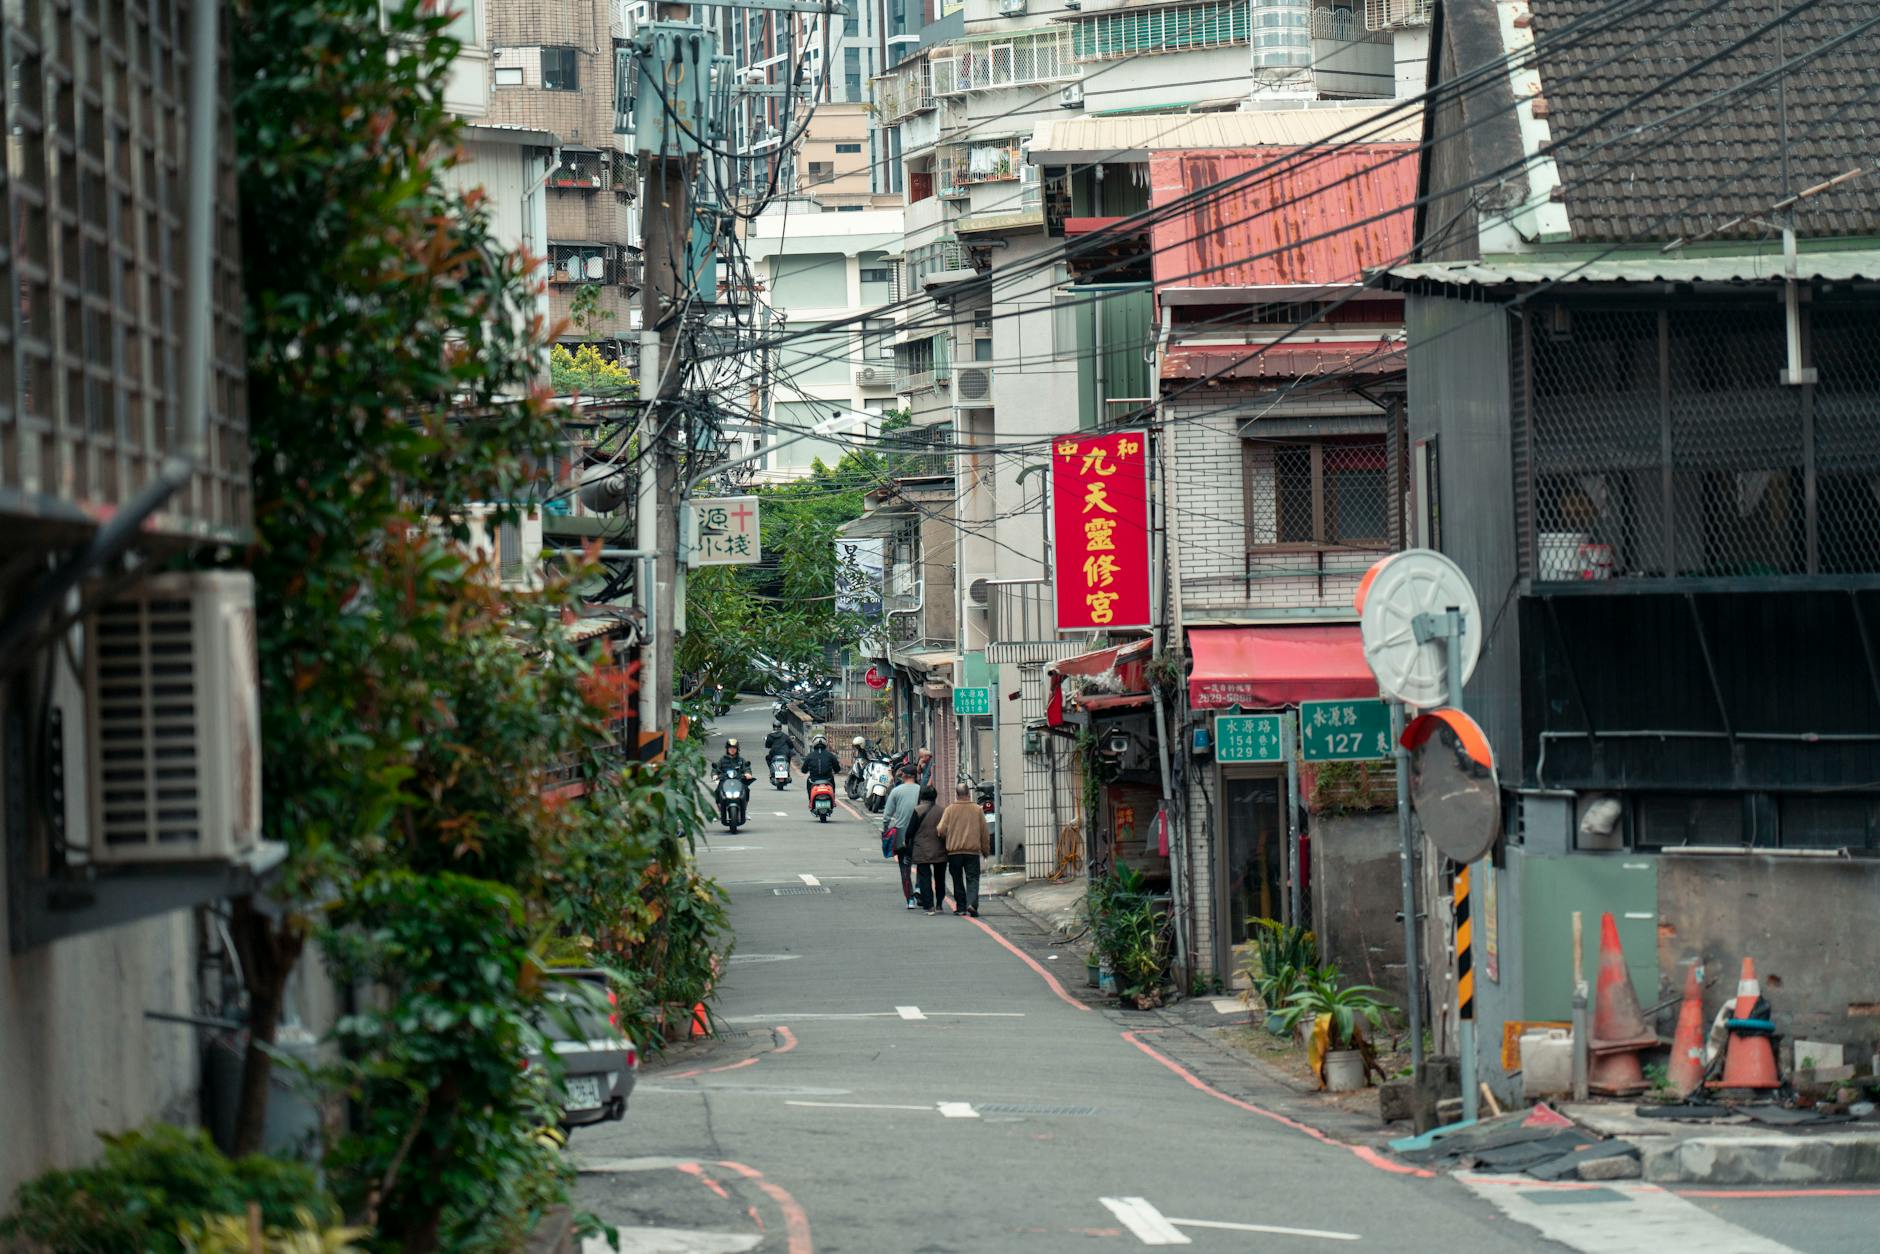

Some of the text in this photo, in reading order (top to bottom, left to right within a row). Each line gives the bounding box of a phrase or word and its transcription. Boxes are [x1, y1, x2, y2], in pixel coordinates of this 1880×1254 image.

[698, 507, 729, 528] 源
[1079, 446, 1121, 624] 九天靈修宮
[1226, 719, 1271, 734] 水源路
[1312, 706, 1357, 728] 水源路
